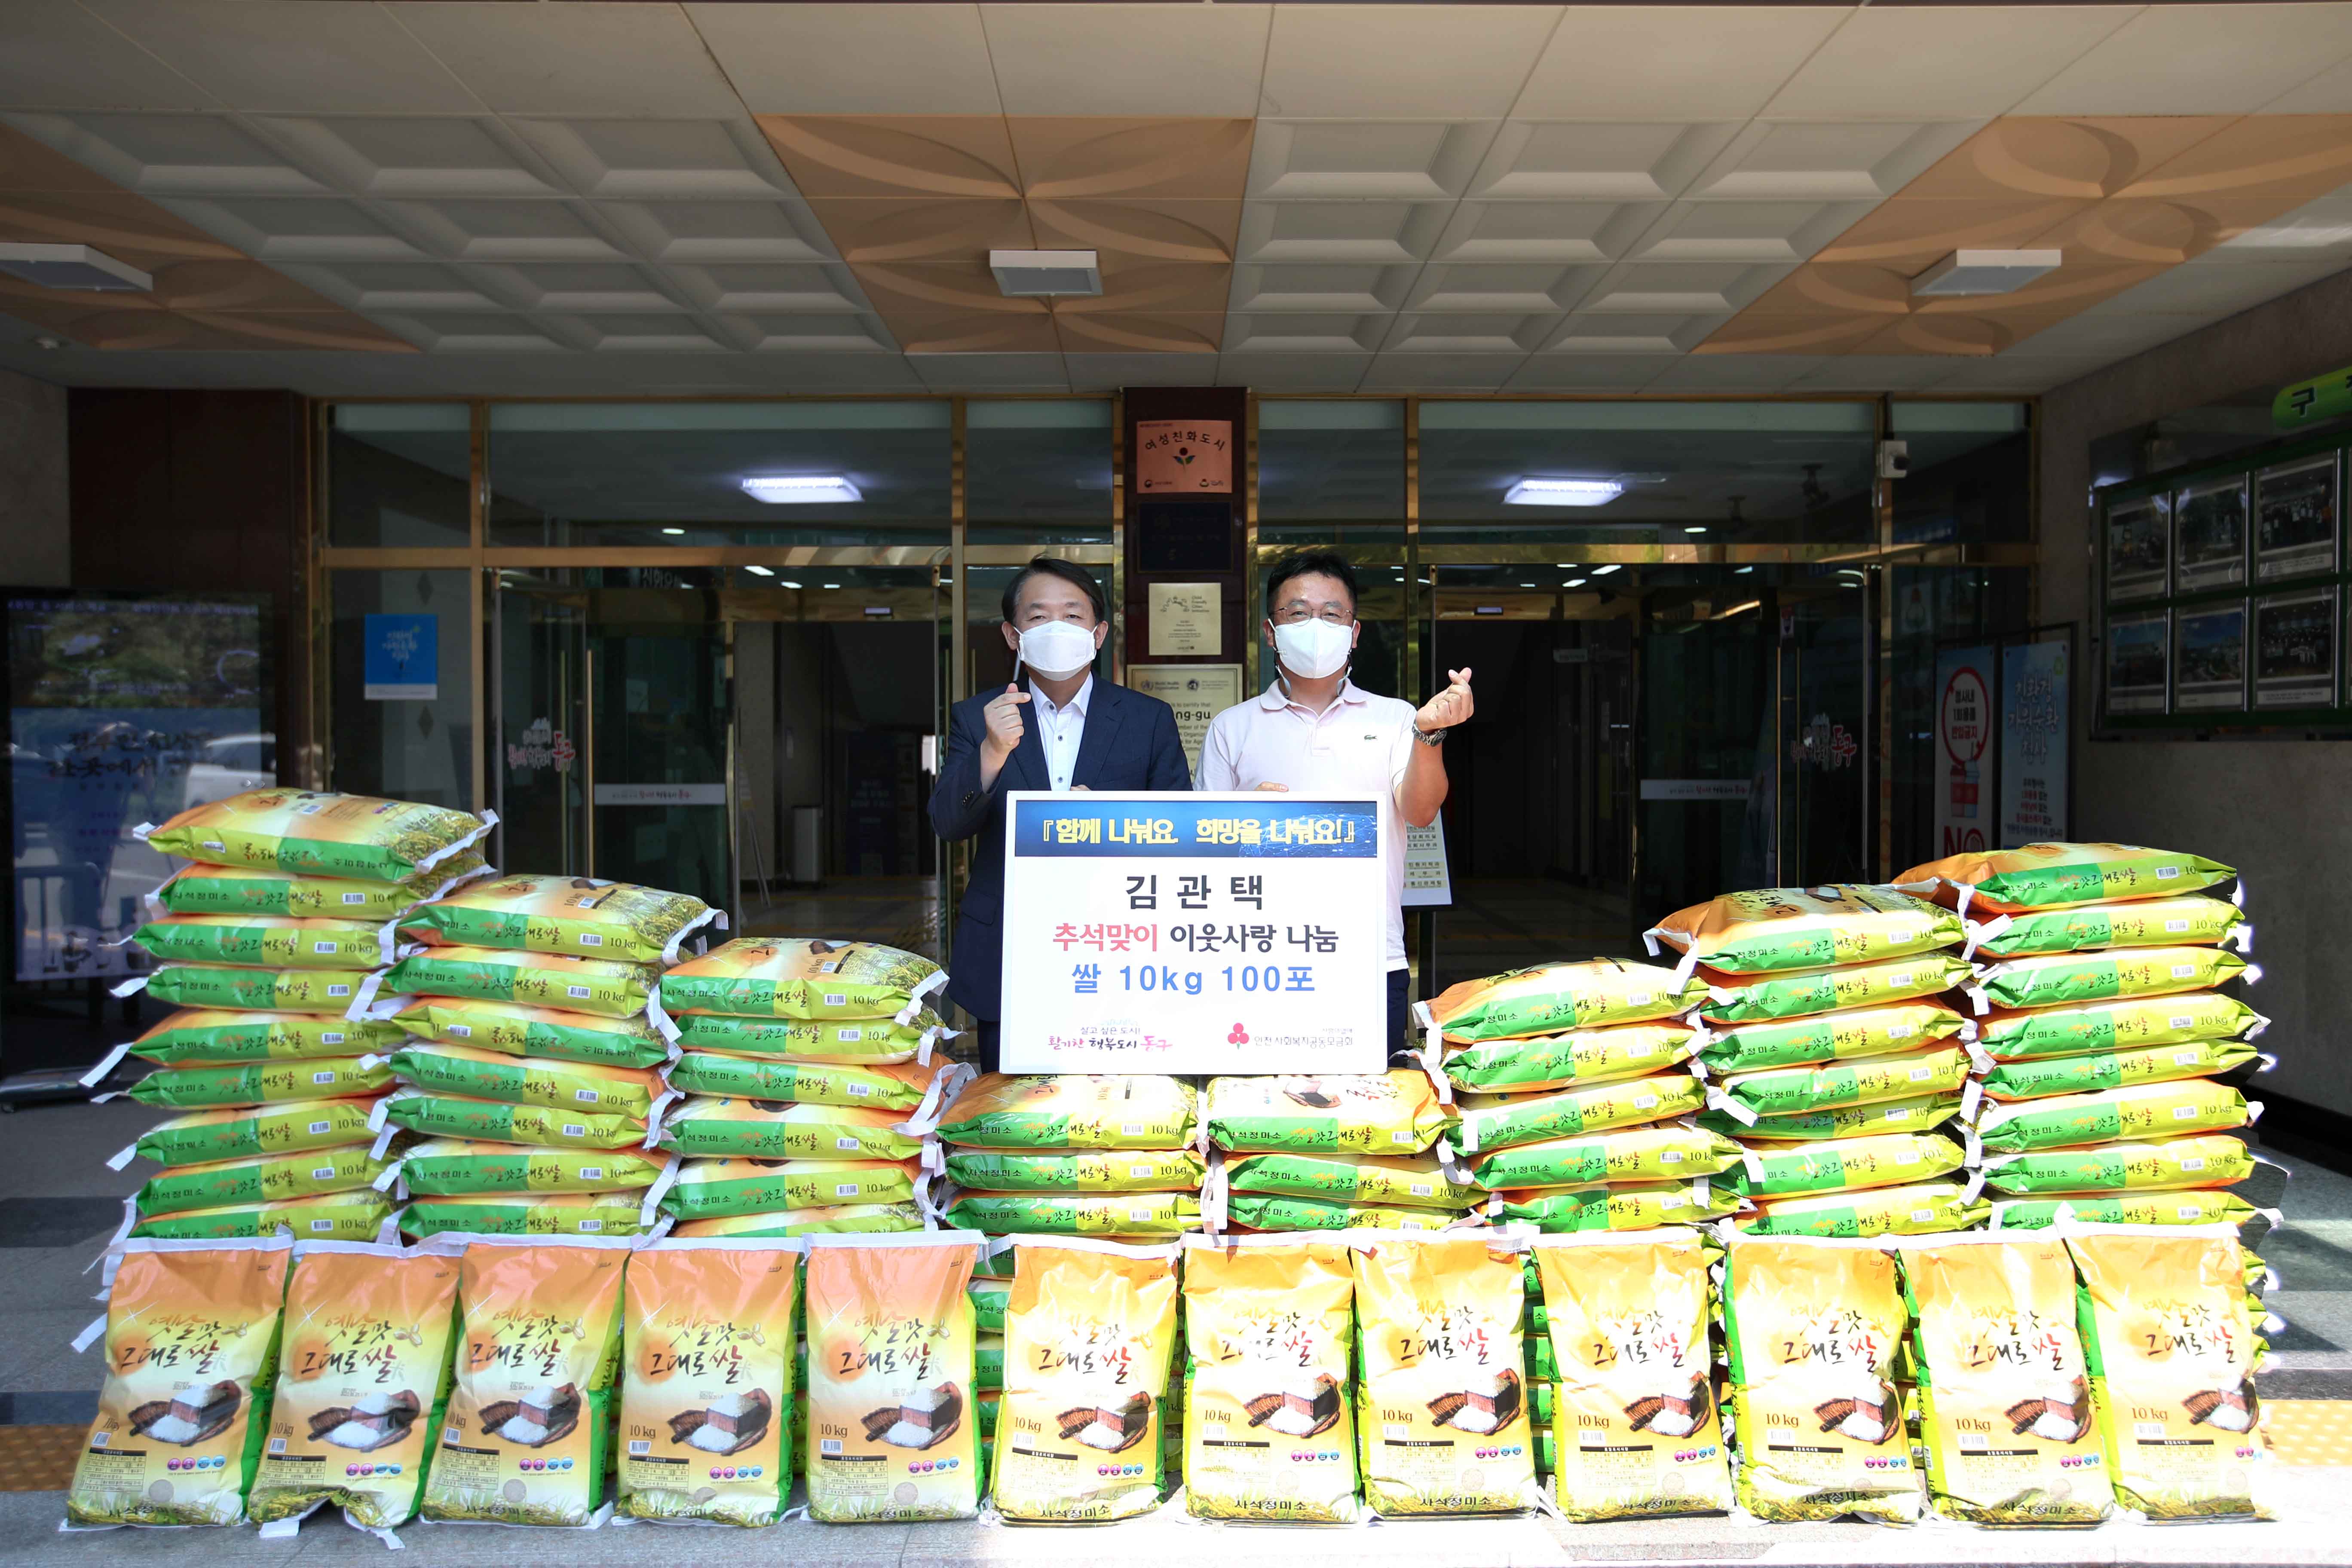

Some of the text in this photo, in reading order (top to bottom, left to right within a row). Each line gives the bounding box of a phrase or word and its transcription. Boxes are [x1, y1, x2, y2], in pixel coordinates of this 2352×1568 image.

[1145, 431, 1225, 451] 여성친화도시
[1176, 711, 1211, 721] ng-gu
[1196, 819, 1261, 845] 희망을
[1053, 924, 1338, 952] 추석맞이 이웃사랑 나눔
[1072, 964, 1315, 995] 쌀 10kg 100포
[1048, 1035, 1173, 1052] 활기찬 행복도시 동구
[1254, 1036, 1353, 1049] 인천 사회복지공동모금회
[1204, 1410, 1231, 1425] 10 kg
[1382, 1409, 1413, 1425] 10 kg
[1766, 1414, 1800, 1428] 10 kg
[2132, 1408, 2168, 1421] 10 kg
[274, 1422, 293, 1437] 10 kg
[1014, 1416, 1041, 1433] 10 kg
[1577, 1415, 1610, 1430] 10 kg
[1956, 1418, 1991, 1433] 10 kg
[630, 1425, 656, 1439] 10 kg
[821, 1424, 848, 1438] 10 kg
